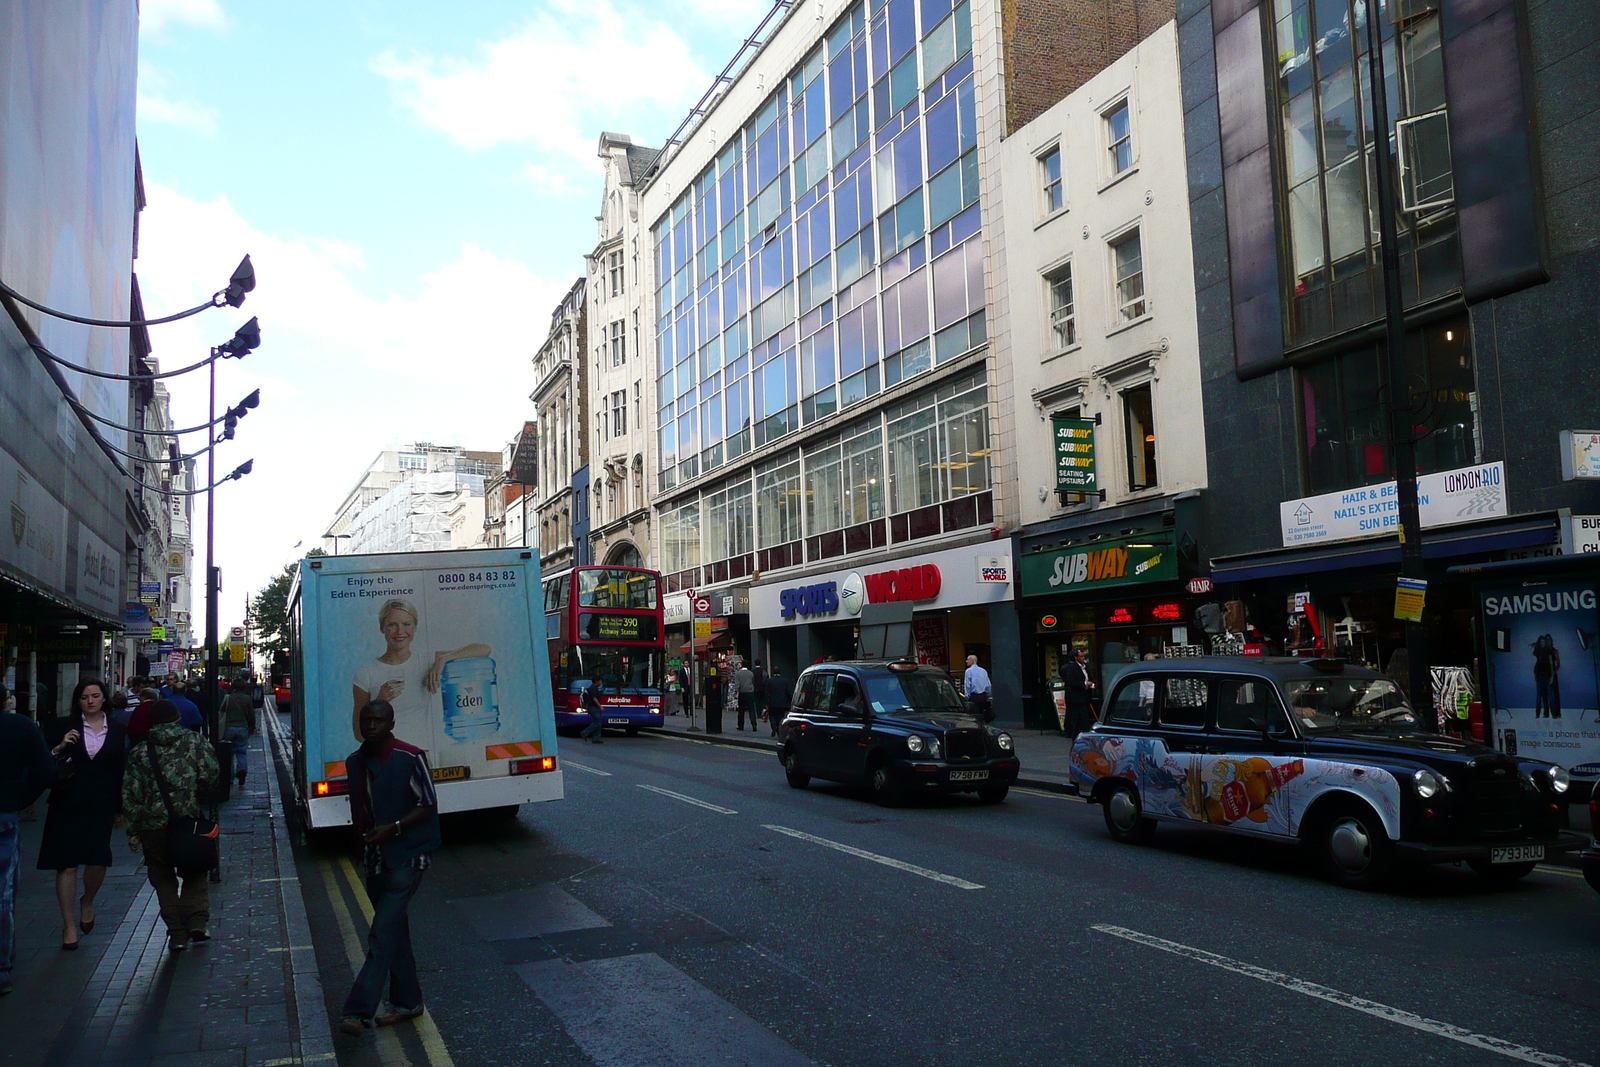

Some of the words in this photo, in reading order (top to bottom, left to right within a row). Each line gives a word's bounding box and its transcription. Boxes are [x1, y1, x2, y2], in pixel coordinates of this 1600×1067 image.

[1057, 428, 1092, 438] SUBWAY
[1058, 442, 1093, 453] SUBWAY
[1059, 456, 1094, 467] SUBWAY
[1058, 469, 1084, 477] SEATING
[1058, 477, 1085, 485] UPSTAIRS
[1342, 491, 1367, 504] HAIR
[1369, 489, 1377, 499] &
[1381, 480, 1422, 497] BEAY
[1334, 505, 1366, 519] NAIL'S
[1368, 494, 1429, 514] EXTENN
[1359, 517, 1380, 530] SUN
[982, 567, 1007, 575] SPORTS
[1048, 547, 1129, 588] SUBWAY
[1134, 552, 1163, 576] SUBWAY
[347, 576, 374, 587] Enjoy
[377, 576, 393, 584] the
[438, 572, 465, 584] 0800
[469, 572, 482, 582] 84
[485, 571, 498, 581] 83
[502, 570, 516, 580] 82
[439, 581, 516, 591] www.edensprings.co.uk
[779, 581, 840, 617] SPORTS
[864, 563, 942, 604] WORLD
[1190, 580, 1210, 592] HAIR
[331, 589, 356, 599] Eden
[359, 586, 414, 599] Experience
[739, 597, 749, 605] 30
[1485, 589, 1597, 616] SAMSUNG
[1158, 603, 1179, 611] SEATING
[623, 617, 638, 627] 390
[918, 619, 937, 629] ALL
[599, 628, 619, 636] Archway
[918, 627, 940, 638] SALE
[917, 637, 944, 649] SHOES
[919, 646, 944, 657] MUST
[926, 656, 941, 666] GO!
[455, 694, 483, 708] Eden
[1519, 730, 1547, 738] imagine
[1555, 730, 1579, 739] phone
[1520, 740, 1541, 749] image
[1542, 740, 1581, 748] conscious
[1226, 786, 1240, 816] Estrella
[1492, 847, 1521, 861] P793
[1523, 846, 1543, 859] RUU
